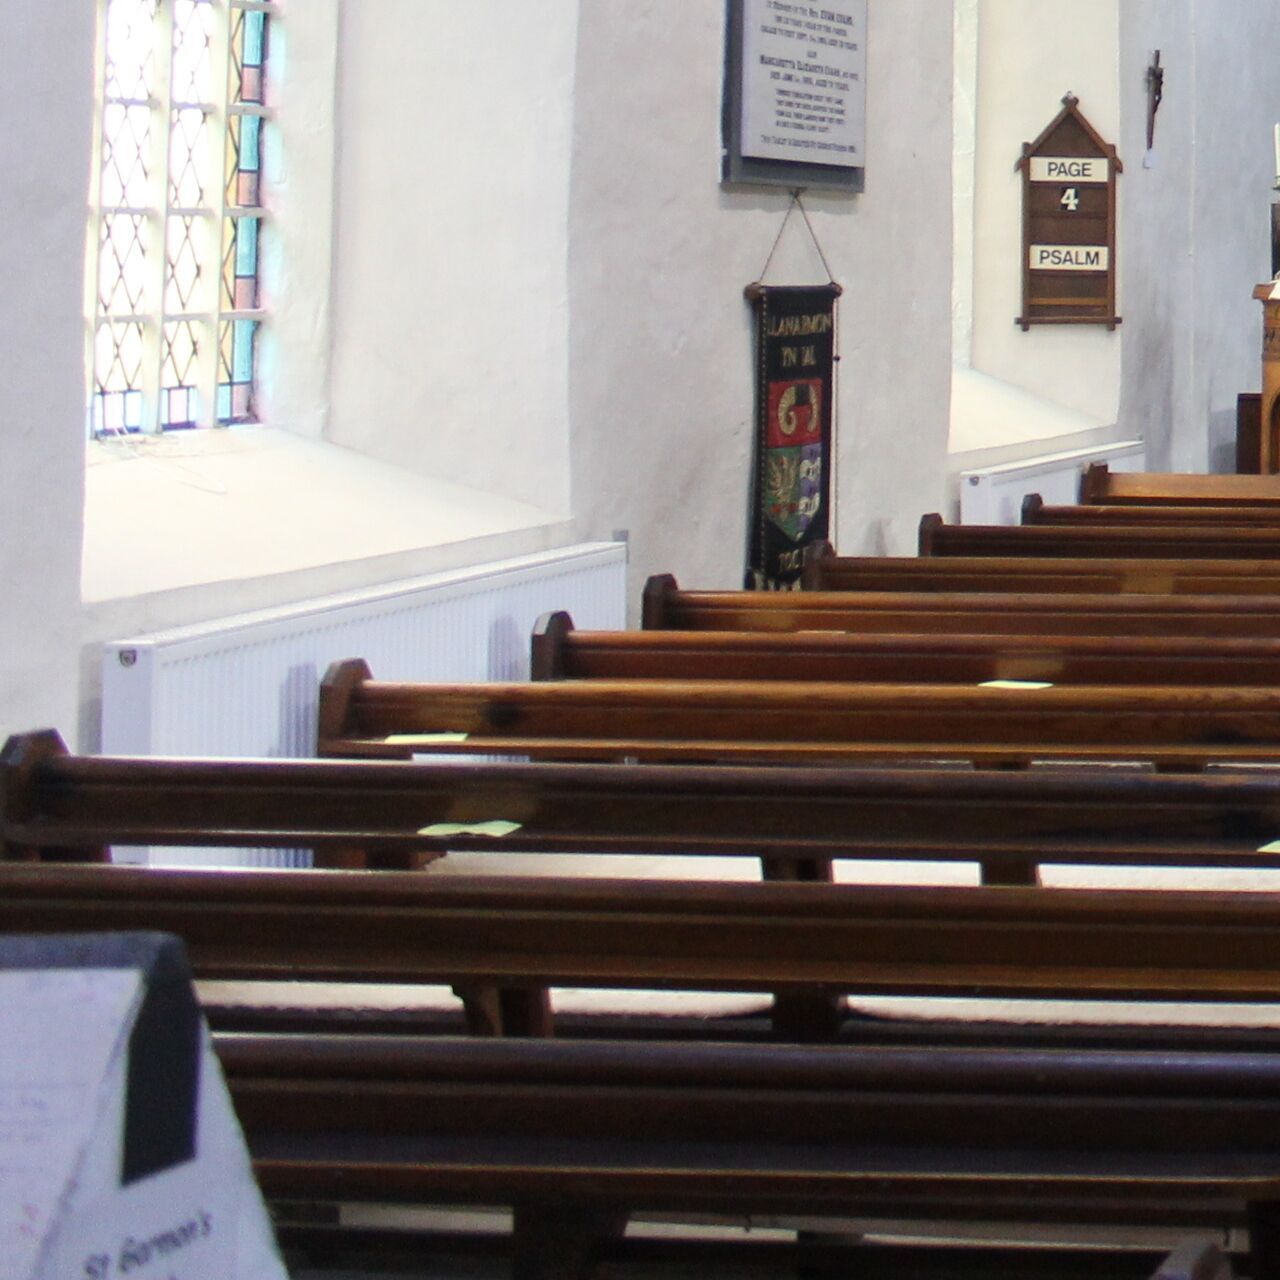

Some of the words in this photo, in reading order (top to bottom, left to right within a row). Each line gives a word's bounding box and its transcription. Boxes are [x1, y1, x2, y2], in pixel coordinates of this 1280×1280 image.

[1047, 161, 1092, 177] PAGE
[1060, 187, 1079, 211] 4
[1039, 250, 1100, 266] PSALM
